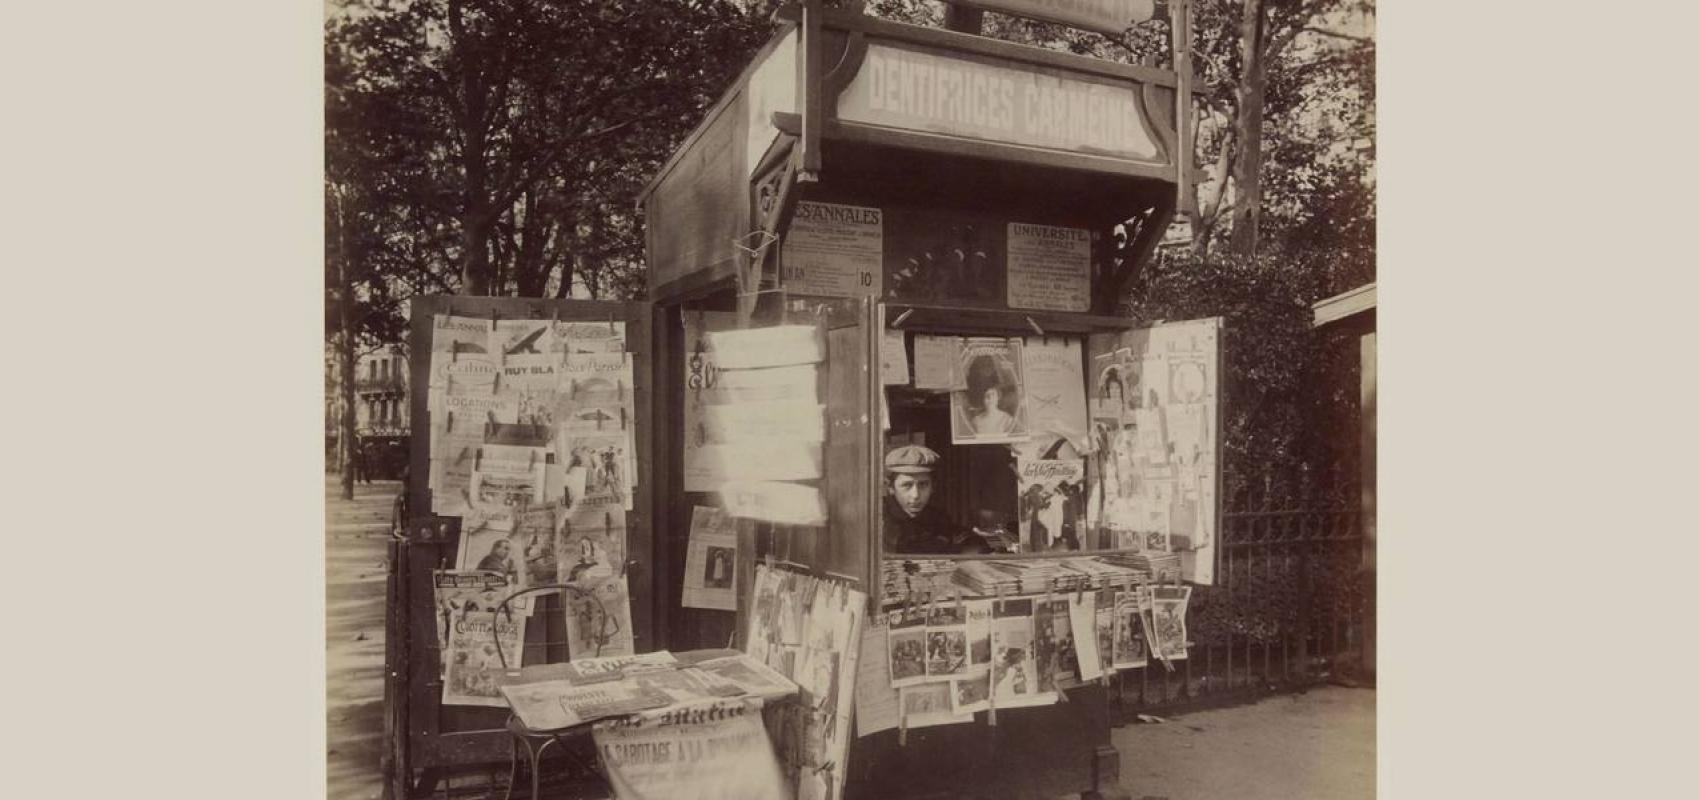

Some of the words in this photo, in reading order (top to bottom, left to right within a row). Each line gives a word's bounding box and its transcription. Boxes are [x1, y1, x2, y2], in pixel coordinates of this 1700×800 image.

[869, 55, 1016, 129] DENTIFRICES
[811, 204, 880, 226] ANNALES
[860, 271, 872, 288] 10
[504, 365, 527, 376] RUY
[530, 365, 555, 376] BLA
[614, 741, 671, 767] SABOTAGE
